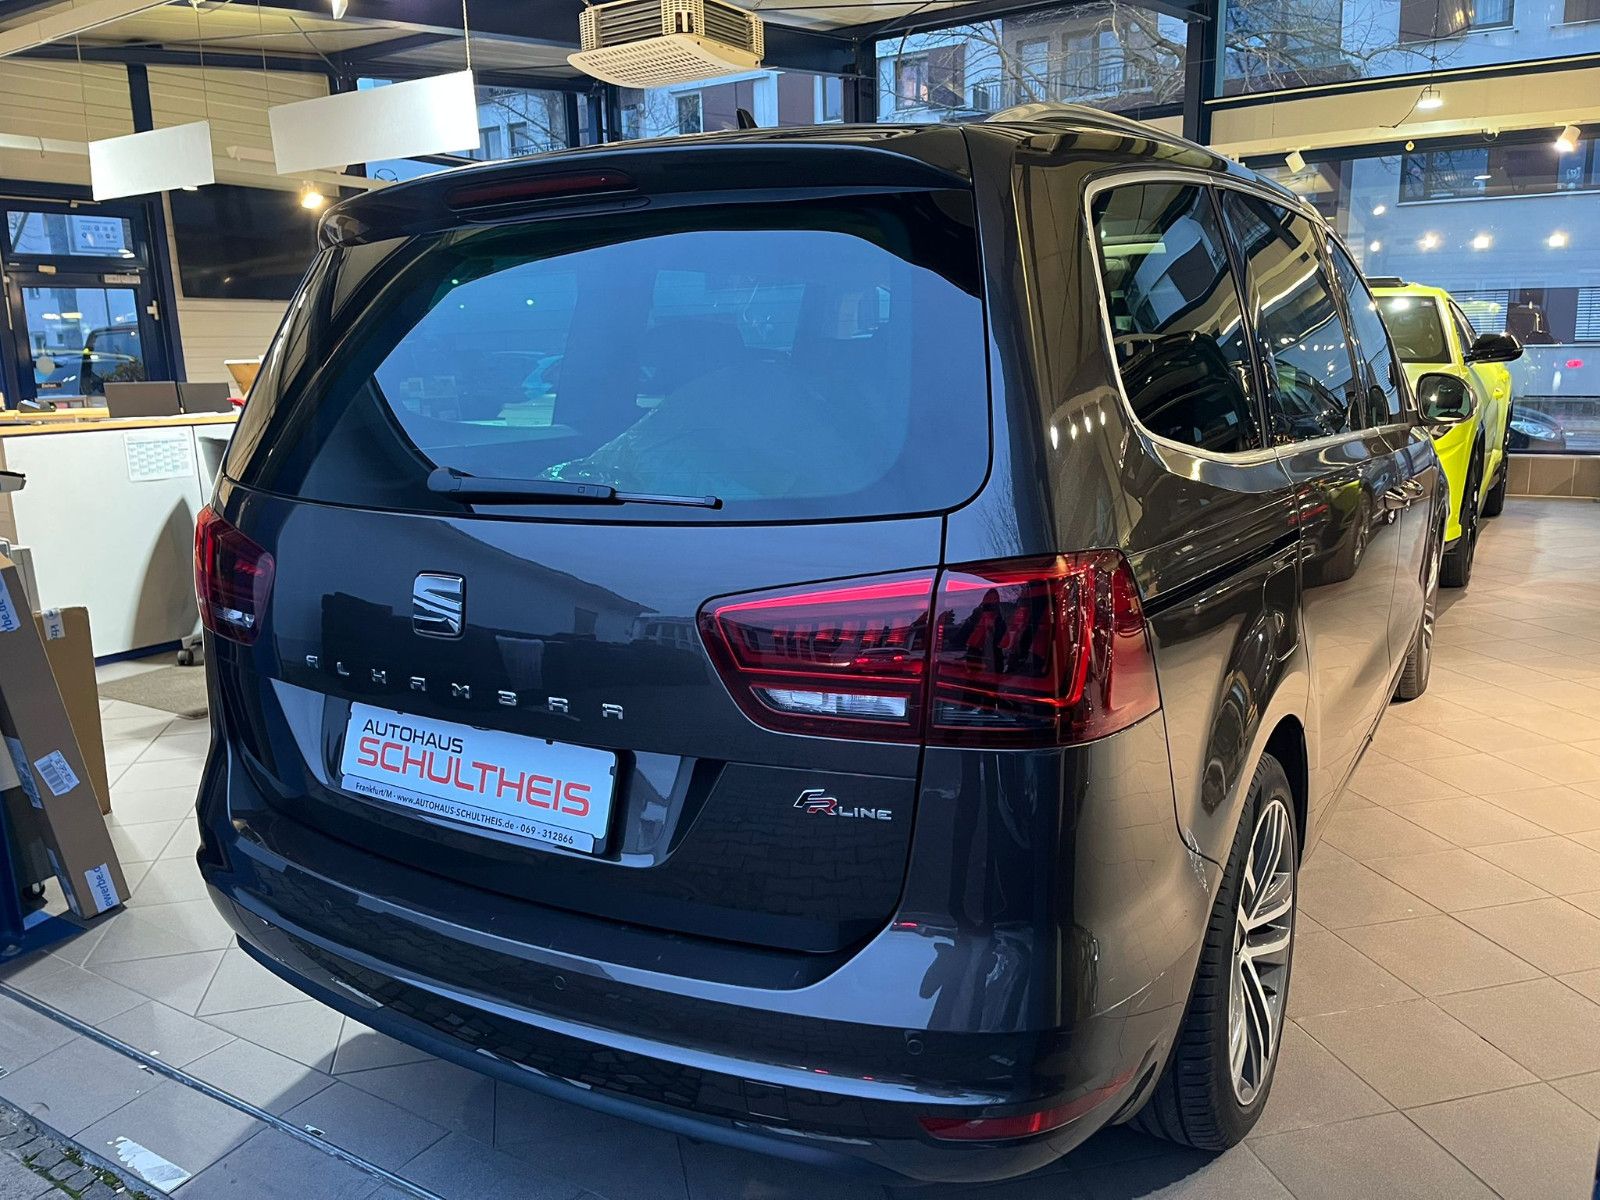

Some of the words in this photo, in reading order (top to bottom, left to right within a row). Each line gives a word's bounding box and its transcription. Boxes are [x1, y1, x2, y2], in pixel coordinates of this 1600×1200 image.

[306, 655, 624, 720] ALHAMBRA
[362, 718, 464, 754] AUTOHAUS
[357, 736, 591, 817] SCHULTHEIS
[839, 806, 892, 820] LINE
[520, 823, 536, 834] 069
[542, 829, 574, 845] 312866
